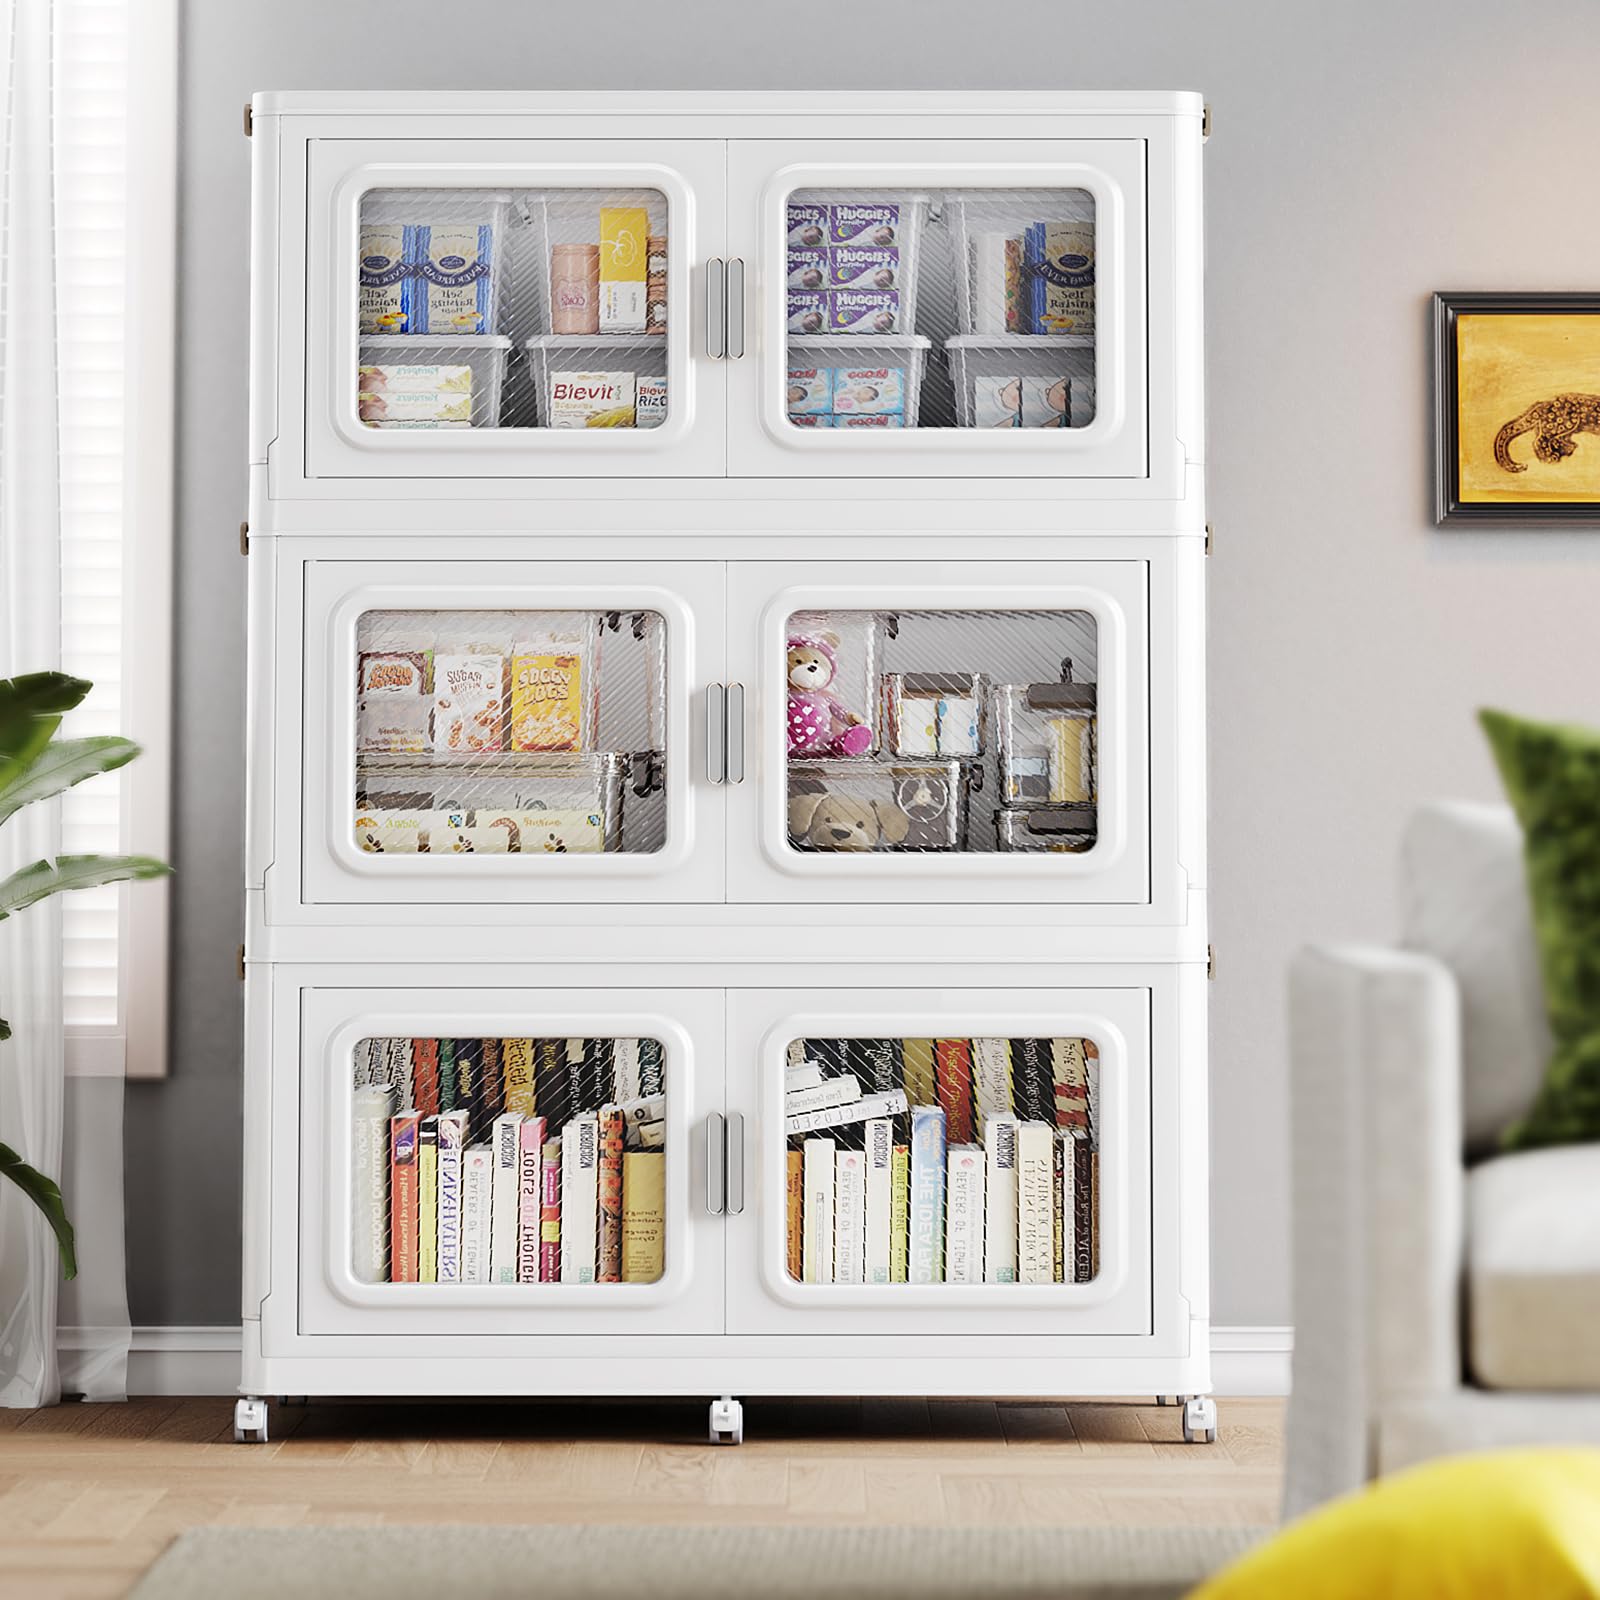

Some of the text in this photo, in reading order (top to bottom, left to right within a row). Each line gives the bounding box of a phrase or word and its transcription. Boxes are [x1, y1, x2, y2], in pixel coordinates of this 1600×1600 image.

[836, 206, 891, 220] HUGGIES
[836, 249, 891, 263] HUGGIES
[836, 292, 891, 306] HUGGIES
[1061, 290, 1085, 299] Self
[447, 669, 482, 684] SUGAR
